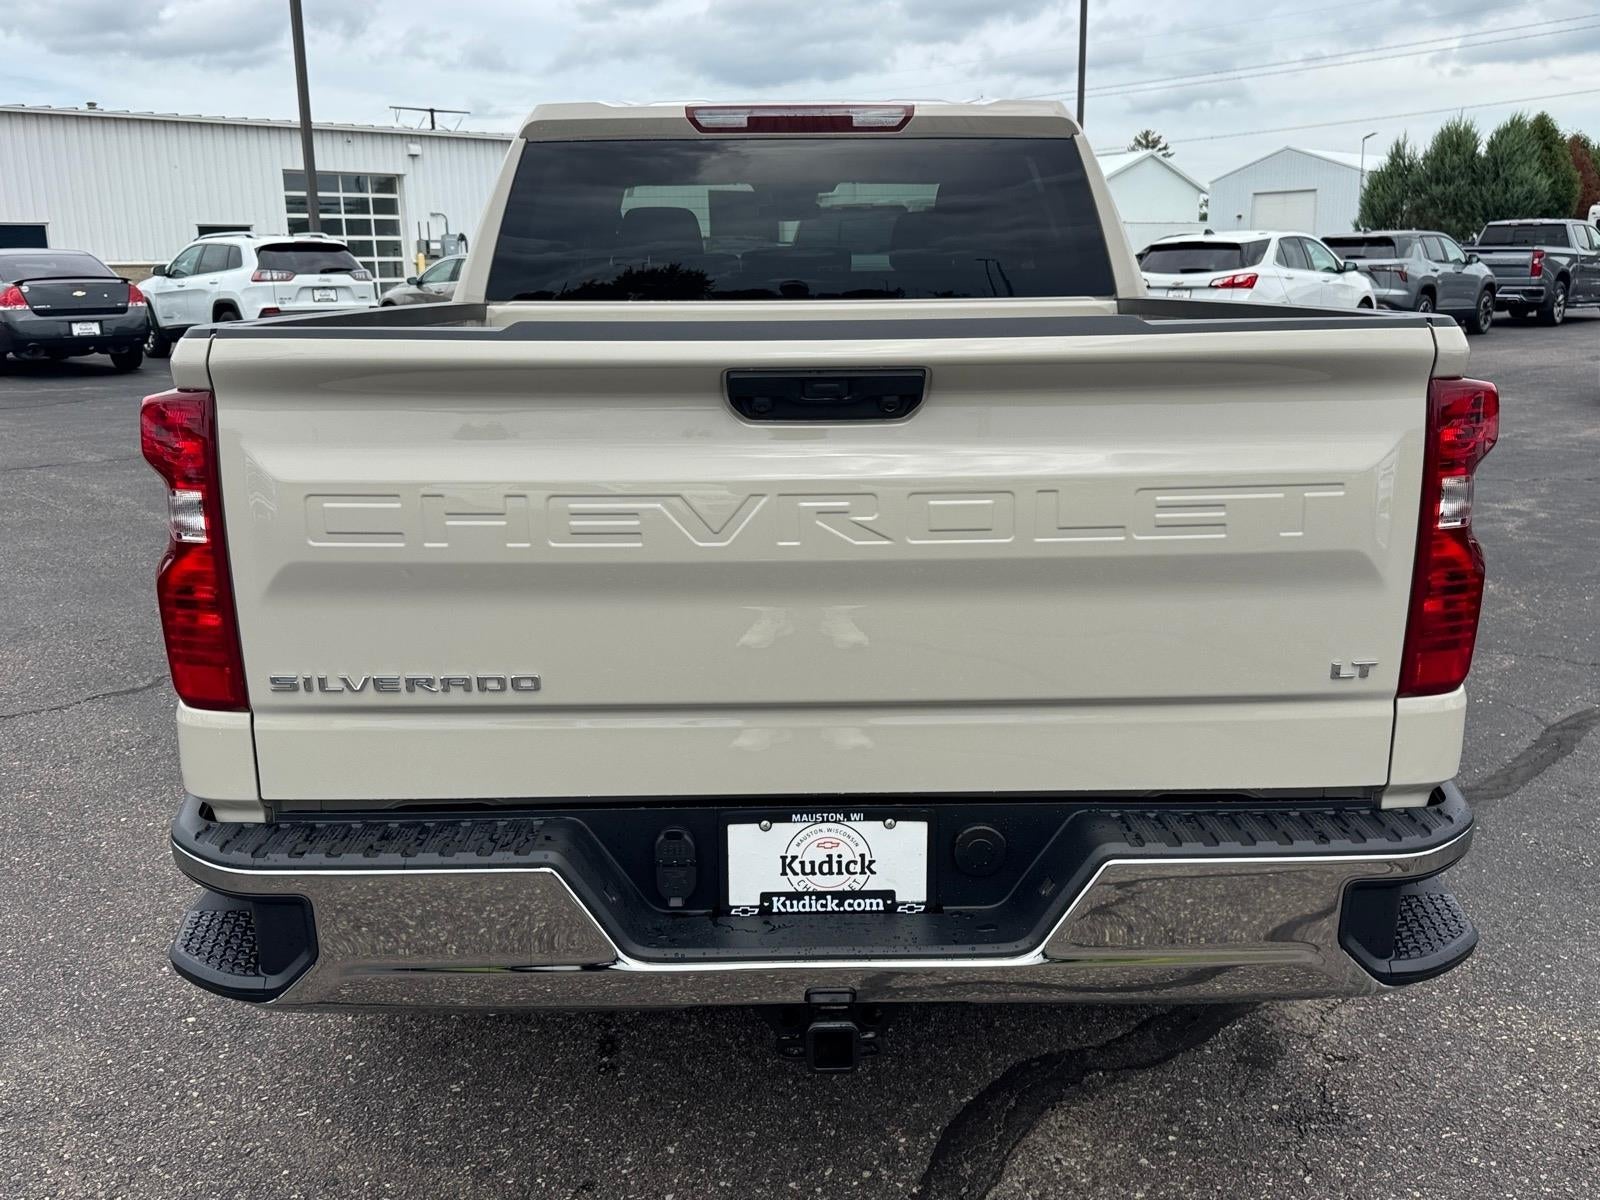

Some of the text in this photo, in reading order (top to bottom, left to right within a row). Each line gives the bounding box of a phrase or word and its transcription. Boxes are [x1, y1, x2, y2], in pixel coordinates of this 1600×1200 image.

[304, 482, 1346, 549] CHEVROLET
[1330, 659, 1379, 680] LT
[269, 673, 541, 692] SILVERADO
[791, 812, 864, 822] MAUSTON, WI
[826, 828, 859, 847] WISCONSIN
[779, 852, 877, 877] Kudick
[772, 895, 884, 913] Kudick.com
